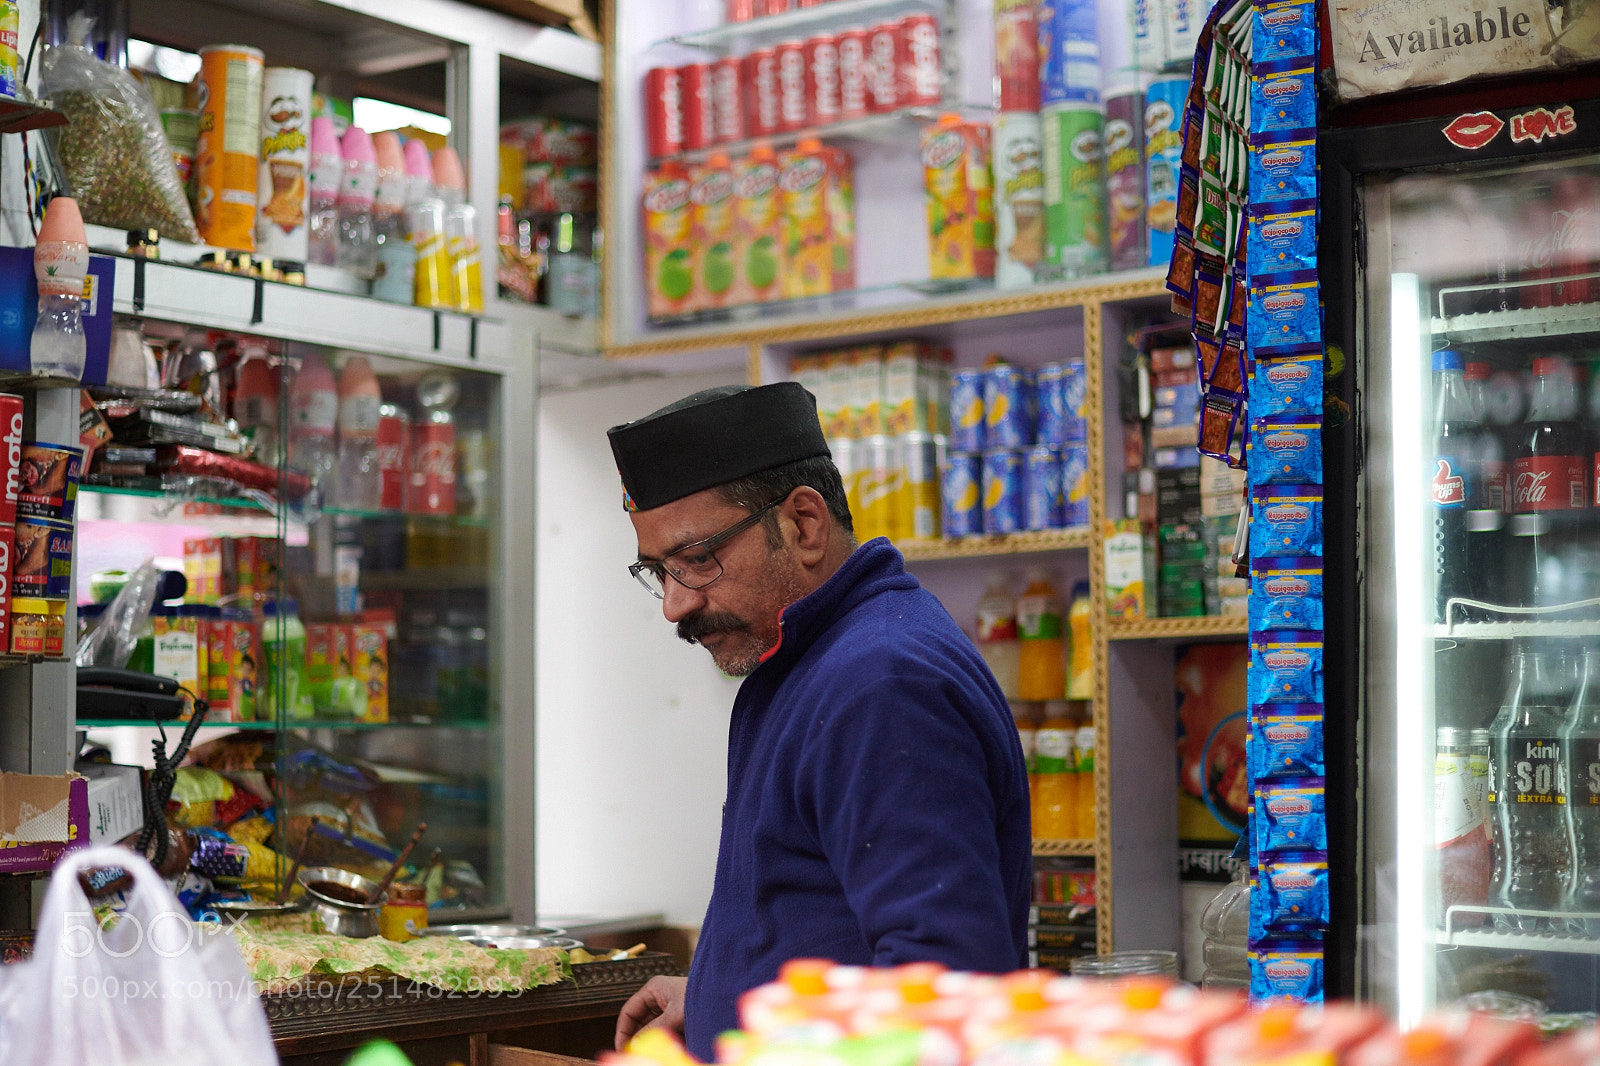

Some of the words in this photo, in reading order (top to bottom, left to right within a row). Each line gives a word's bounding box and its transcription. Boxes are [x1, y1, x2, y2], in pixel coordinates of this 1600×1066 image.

[1358, 6, 1532, 64] Available
[1511, 107, 1576, 141] LOVE
[1438, 488, 1454, 500] UP
[1526, 740, 1560, 759] kinl
[1516, 761, 1567, 794] SOA
[1520, 794, 1553, 804] EXTRA
